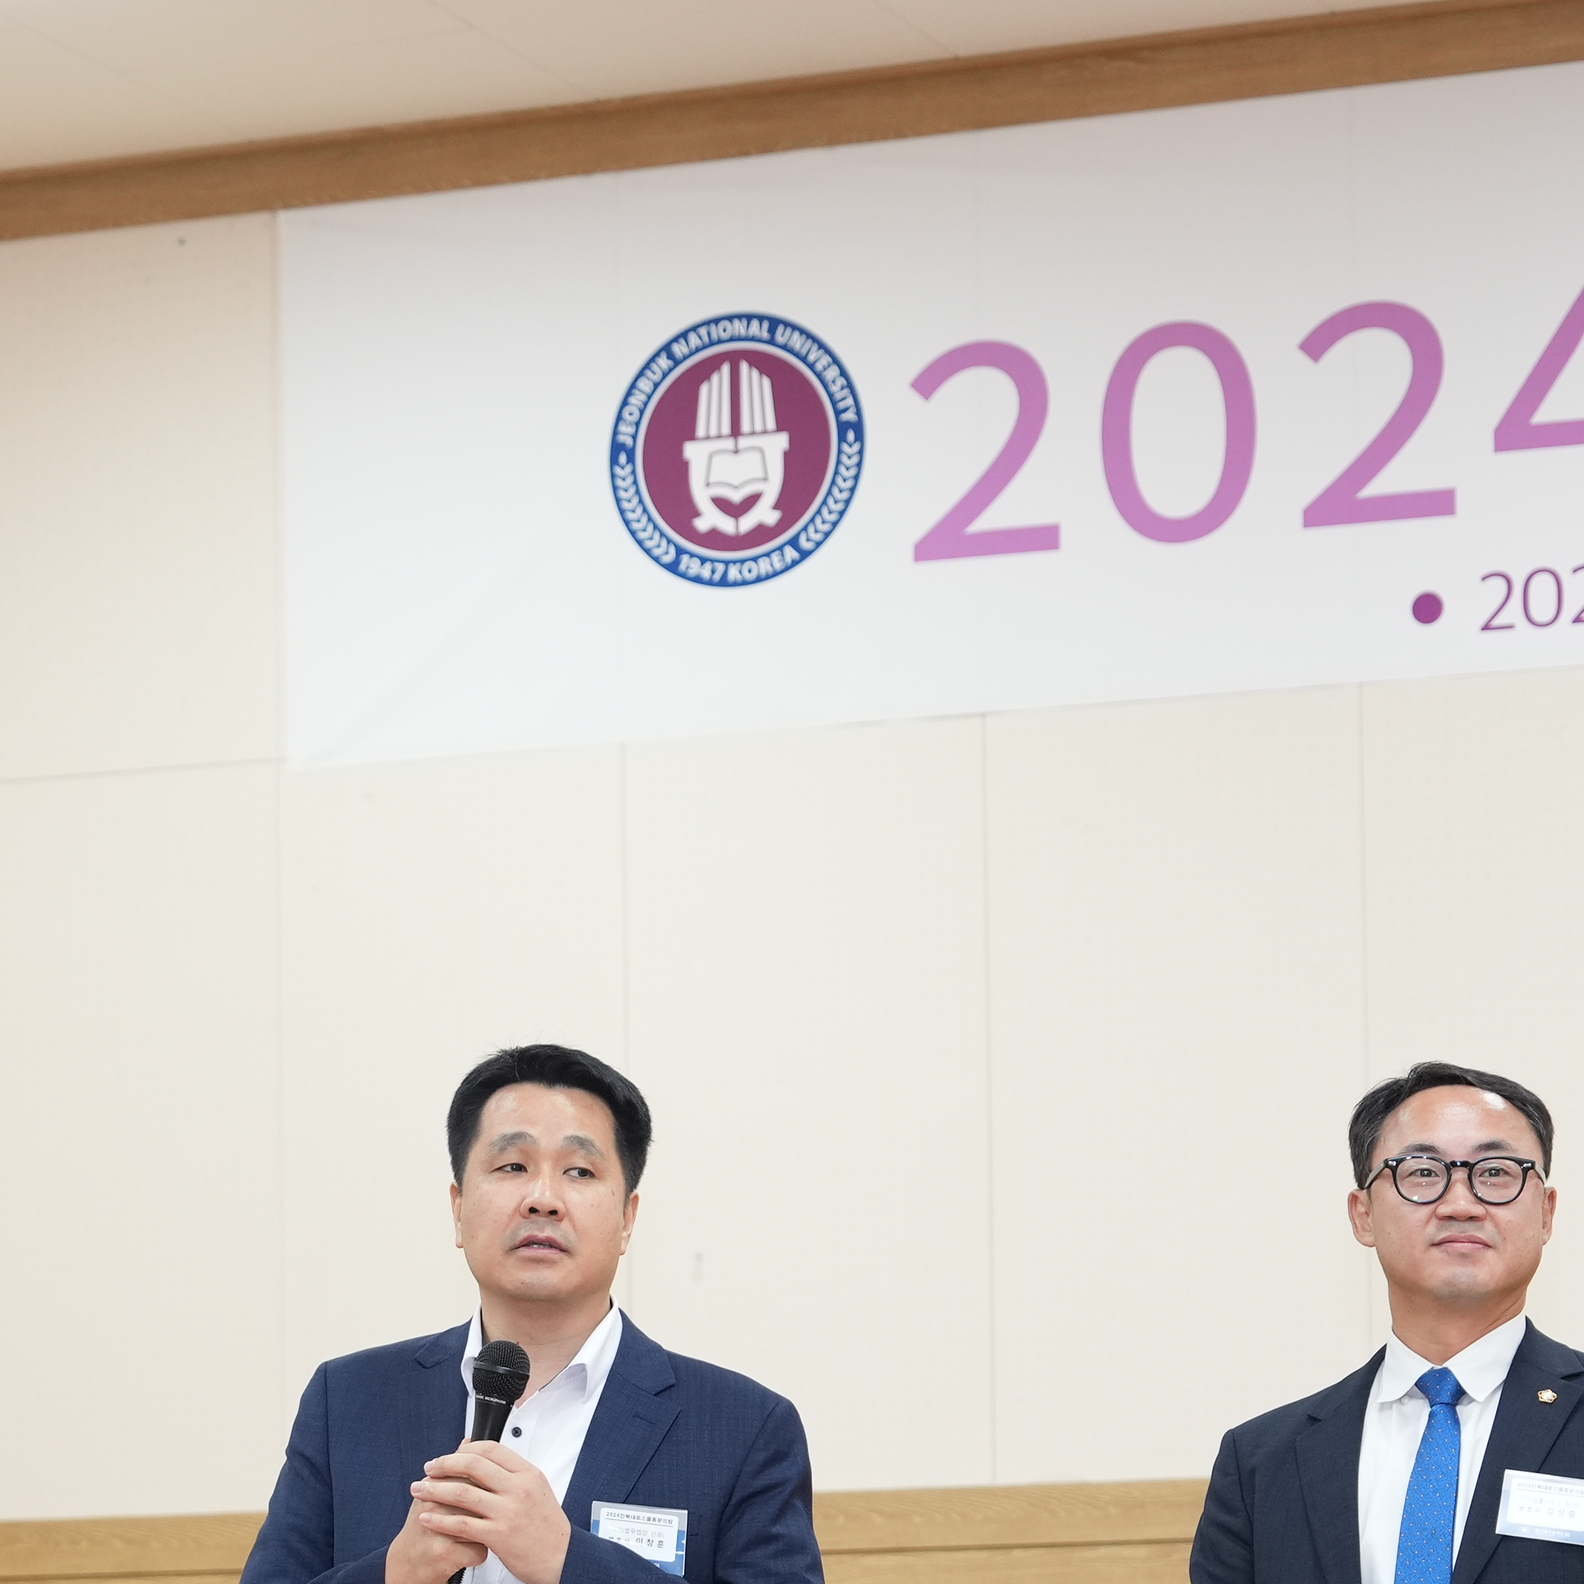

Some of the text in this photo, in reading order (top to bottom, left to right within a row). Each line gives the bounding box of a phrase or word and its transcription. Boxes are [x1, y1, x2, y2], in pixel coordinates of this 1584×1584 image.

[616, 317, 860, 450] JEONBUK NATIONAL UNIVERSITY
[678, 543, 802, 584] 1947 KOREA
